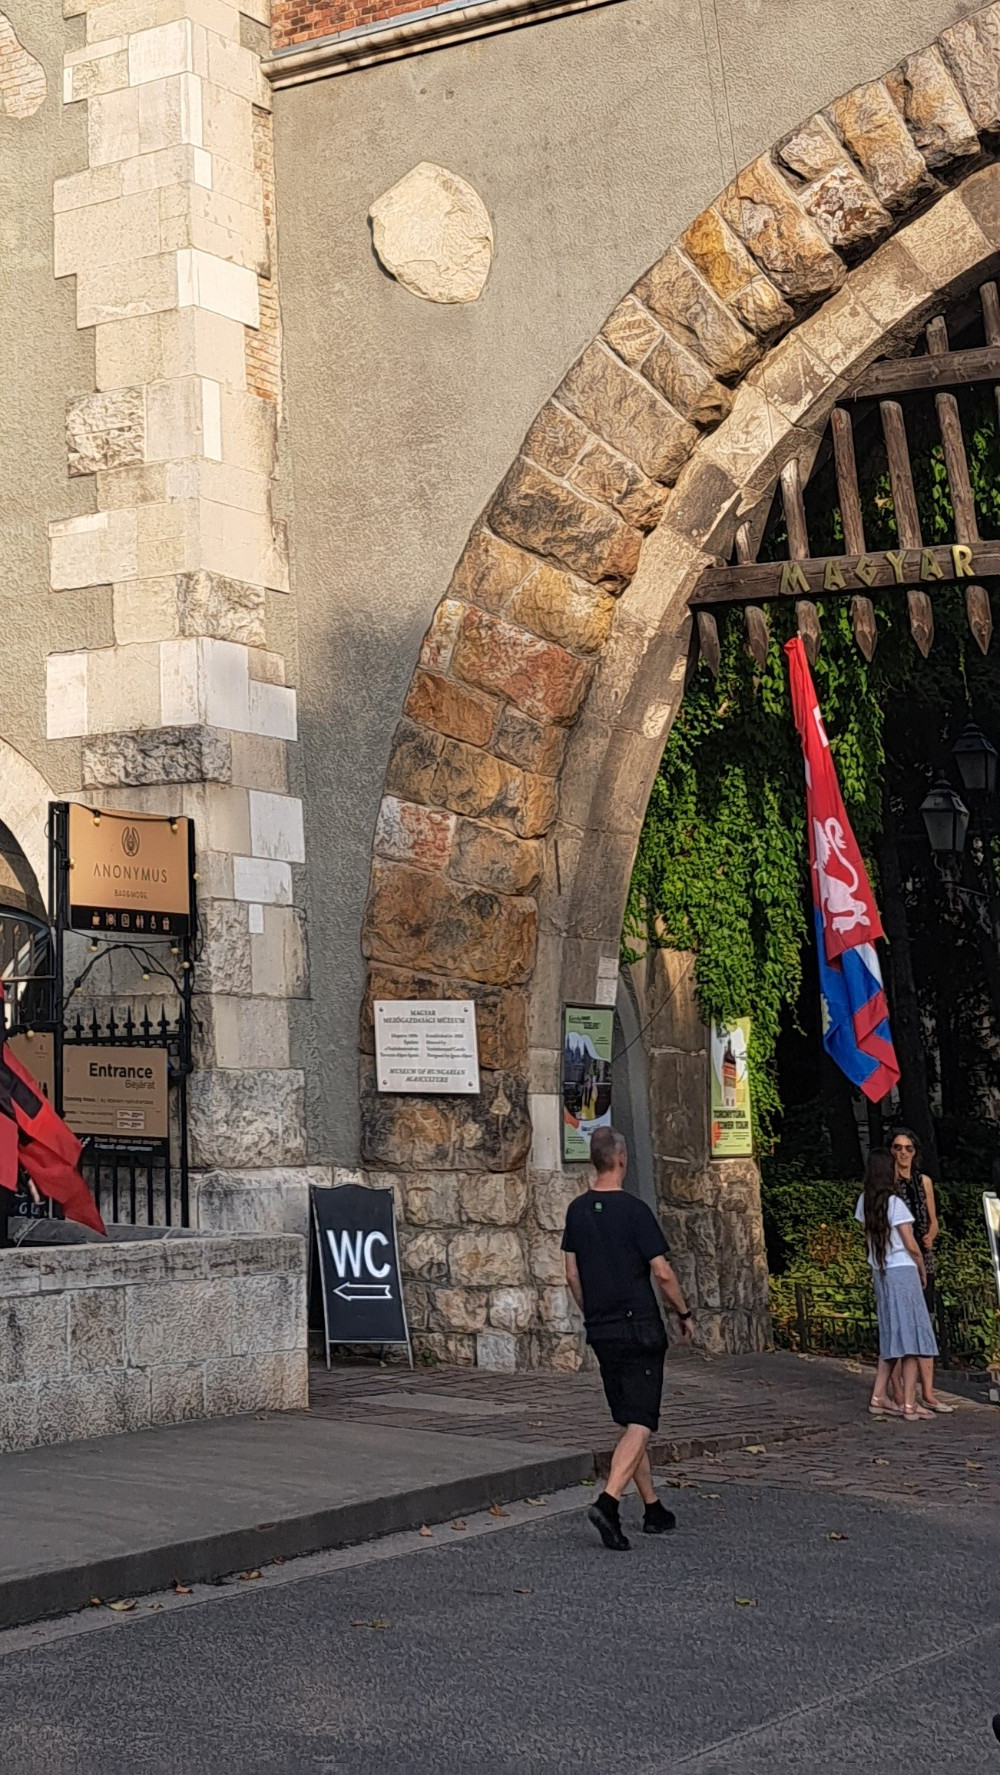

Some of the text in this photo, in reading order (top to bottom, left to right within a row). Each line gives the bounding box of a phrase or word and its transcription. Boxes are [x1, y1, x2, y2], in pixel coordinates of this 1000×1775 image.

[779, 544, 976, 594] MAGYAR
[93, 863, 168, 884] ANONYMUS
[89, 1062, 154, 1079] Entrance
[326, 1229, 391, 1278] WC
